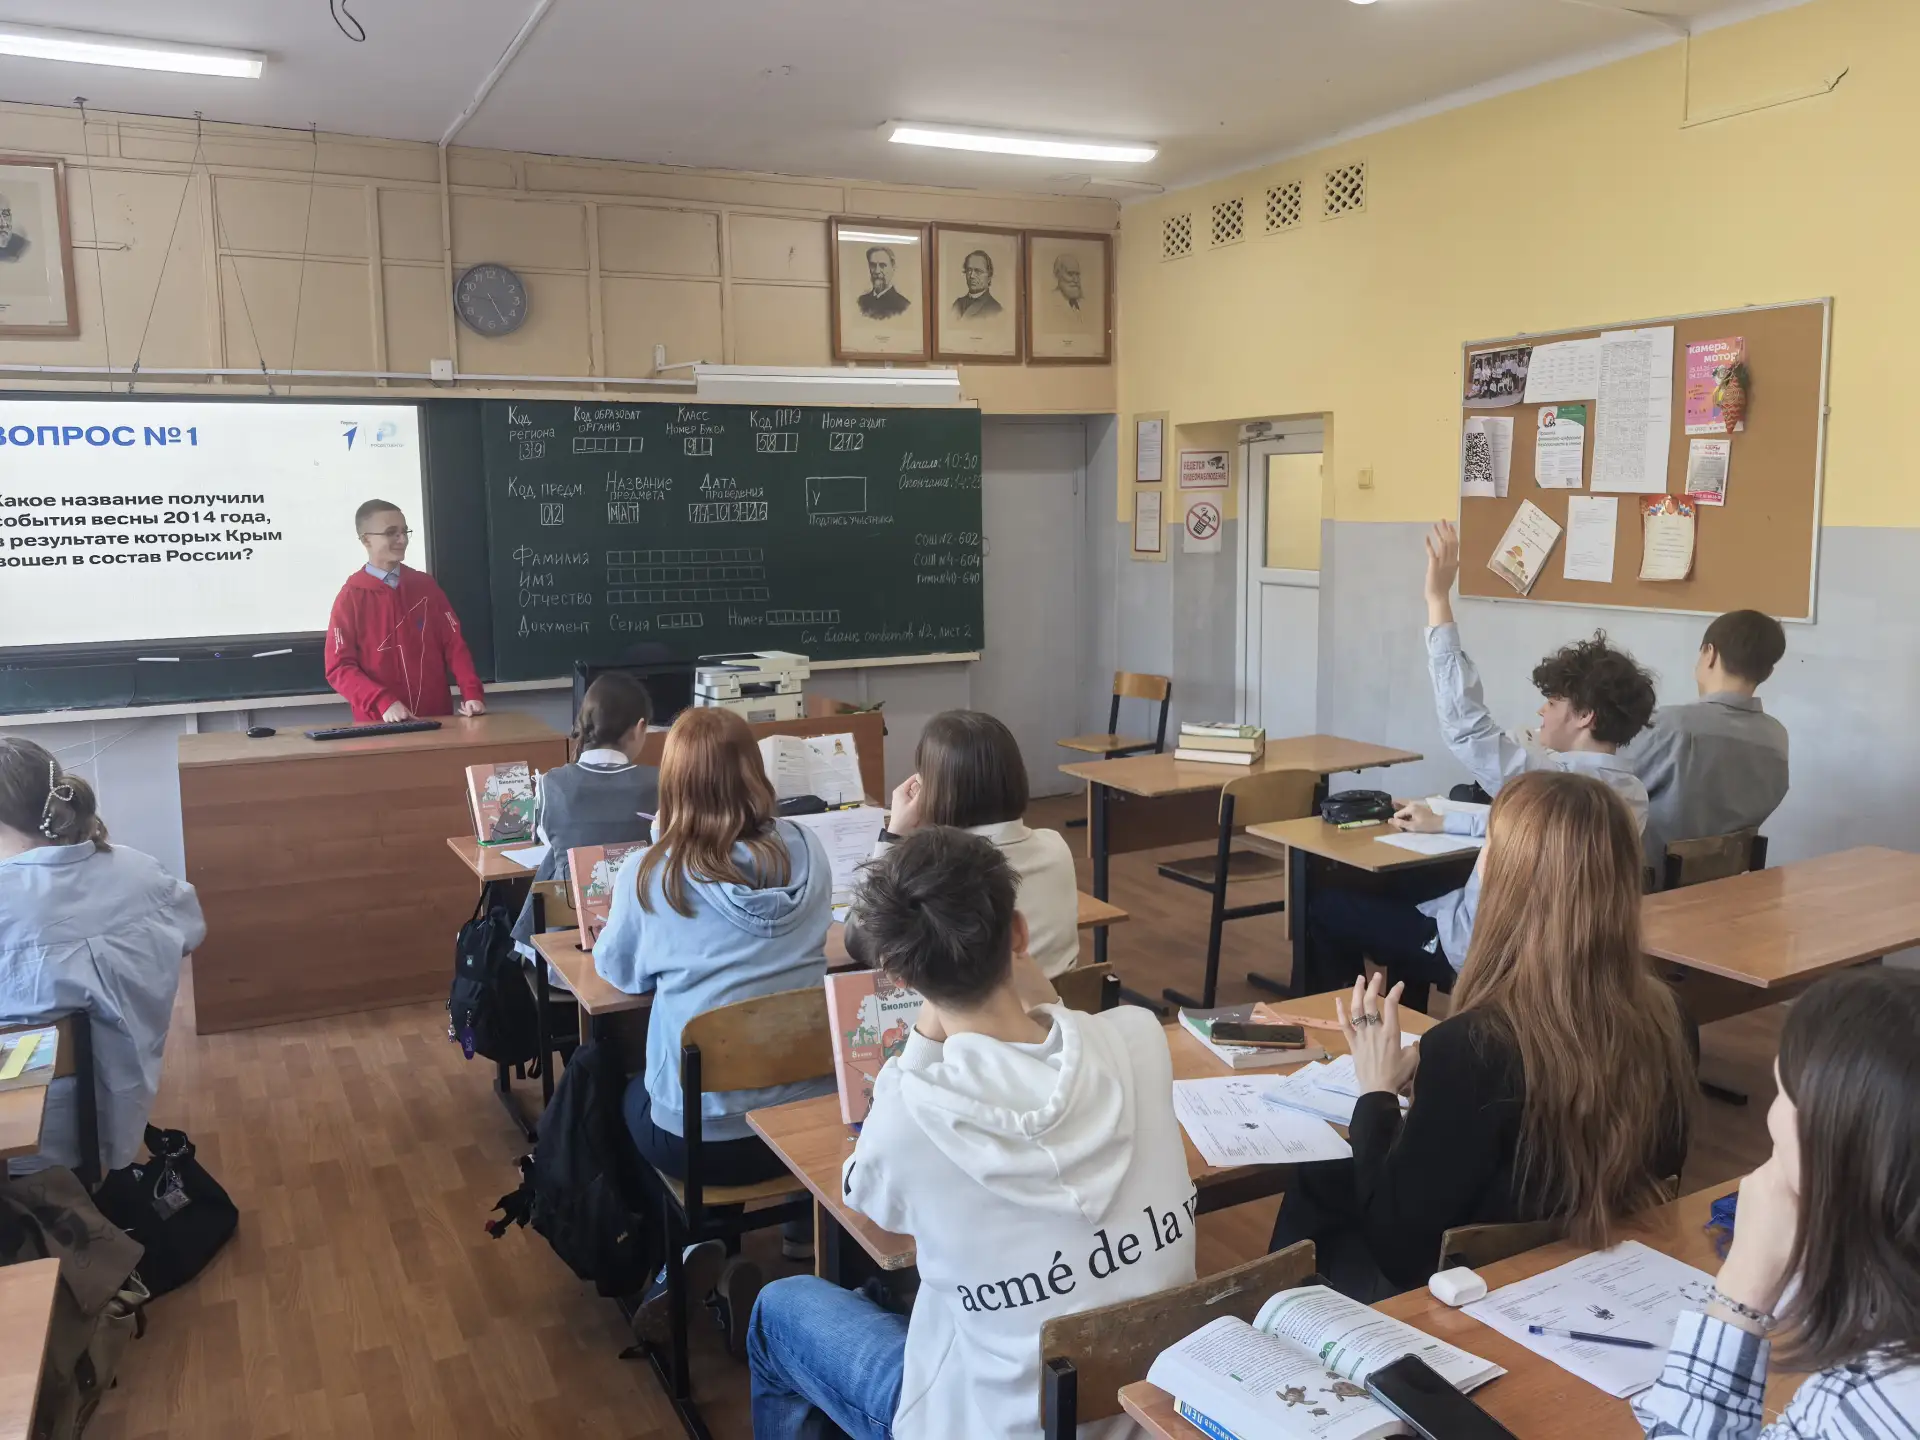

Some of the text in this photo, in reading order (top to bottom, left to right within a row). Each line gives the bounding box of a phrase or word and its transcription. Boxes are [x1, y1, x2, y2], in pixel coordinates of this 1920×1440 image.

[1689, 342, 1730, 354] камера,
[508, 405, 532, 426] Код
[573, 406, 592, 422] Код
[750, 408, 801, 431] Код ППЭ
[822, 412, 857, 429] Номер
[144, 427, 198, 446] №1
[833, 434, 864, 450] 212
[508, 476, 536, 499] Код
[0, 494, 265, 507] акое название получили
[0, 511, 271, 527] обытия весны 2014 года,
[10, 534, 129, 549] результате
[134, 532, 221, 545] которых
[226, 529, 282, 544] Крым
[73, 555, 84, 565] в
[89, 553, 161, 565] состав
[166, 549, 254, 562] России?
[519, 589, 592, 607] Отчество
[518, 605, 763, 639] Документ Серия Номер
[963, 624, 973, 638] 2
[956, 1250, 1077, 1312] acmé
[1088, 1228, 1142, 1279] de
[1143, 1205, 1184, 1252] la
